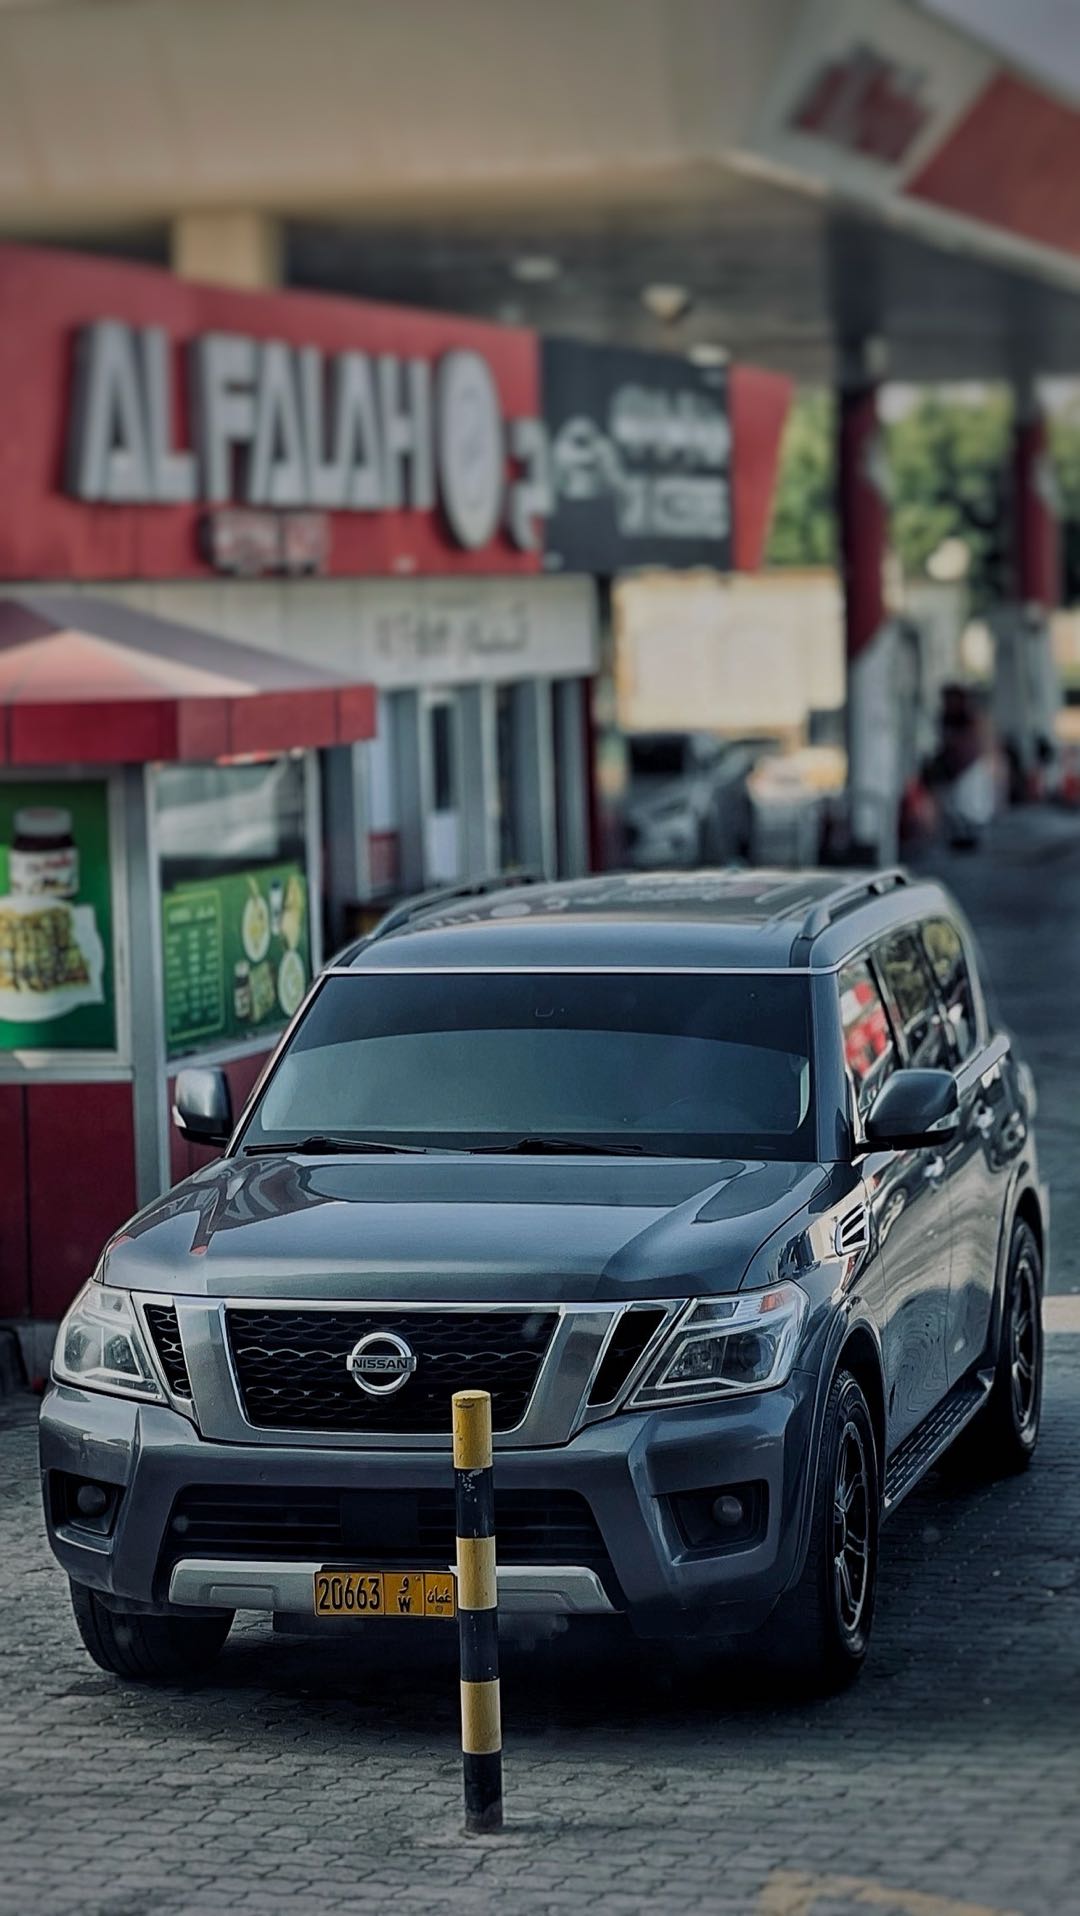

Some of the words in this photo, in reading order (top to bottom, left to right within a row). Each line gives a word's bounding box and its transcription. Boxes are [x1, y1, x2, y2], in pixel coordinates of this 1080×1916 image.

[74, 318, 198, 500] AL
[200, 330, 435, 509] FALAH
[352, 1359, 408, 1369] NISSAN
[318, 1577, 381, 1611] 20663
[397, 1596, 411, 1613] W
